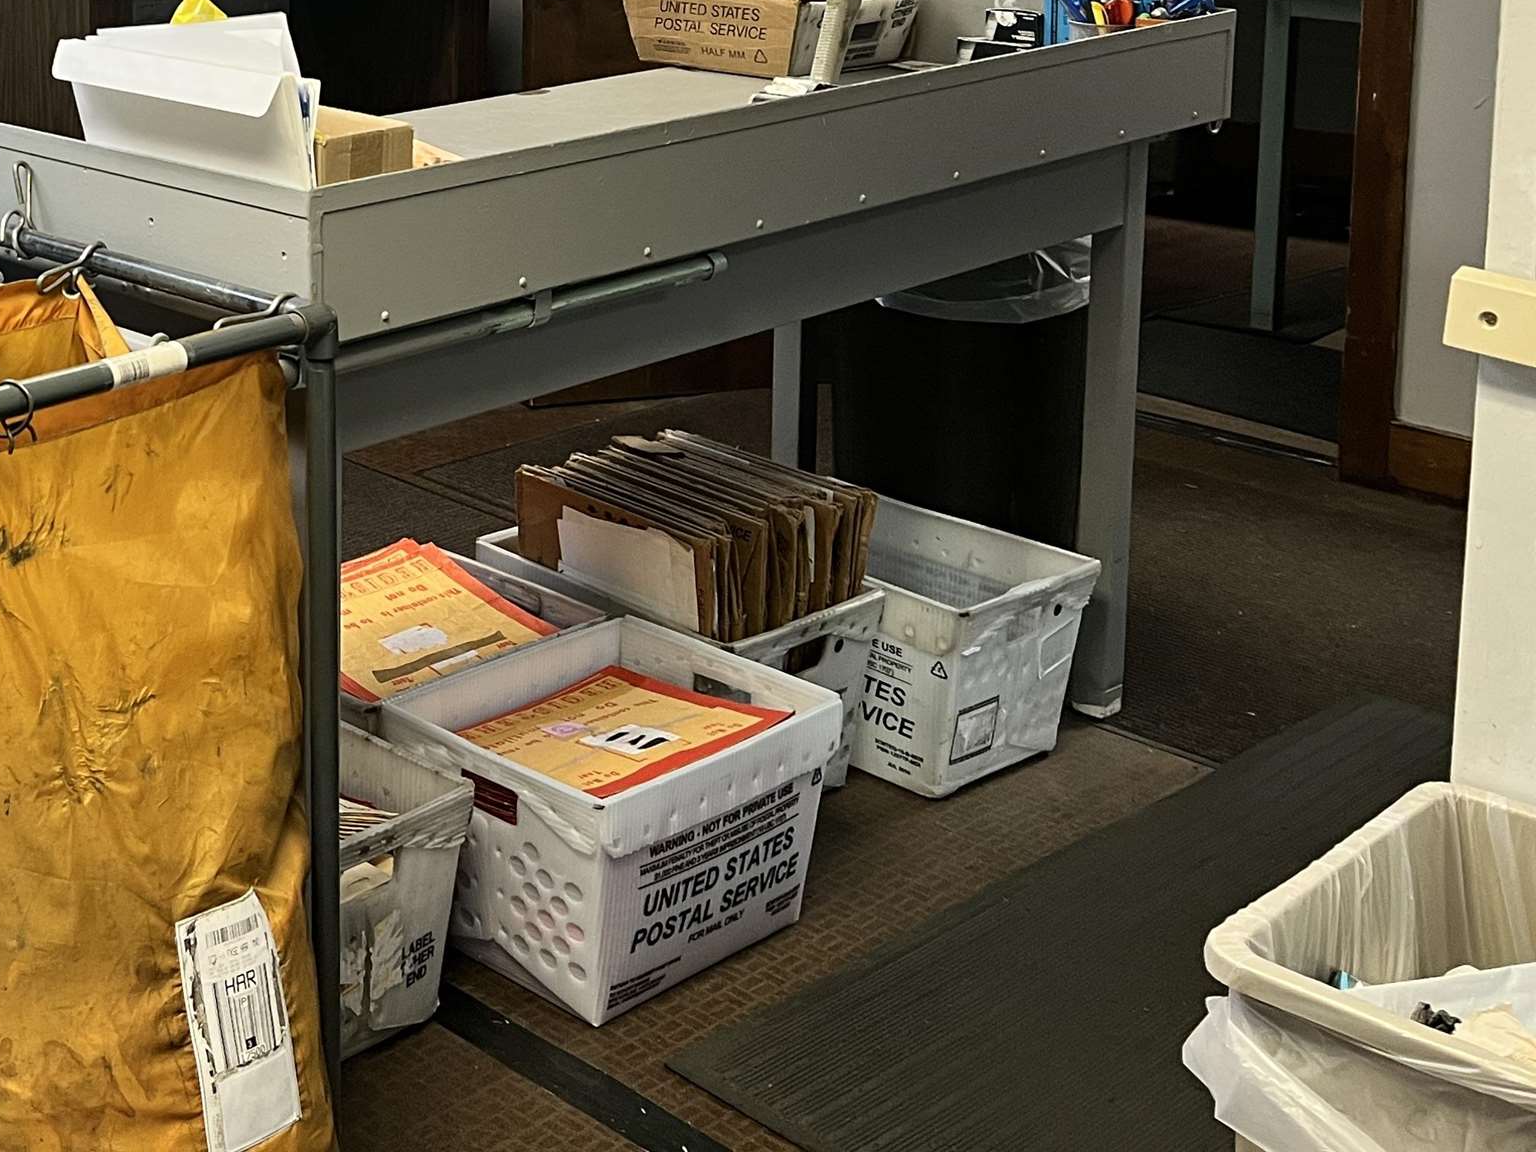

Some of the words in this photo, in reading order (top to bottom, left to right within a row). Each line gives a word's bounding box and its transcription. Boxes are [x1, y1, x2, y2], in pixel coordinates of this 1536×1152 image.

[659, 0, 707, 16] UNITED
[710, 4, 761, 21] STATES
[655, 17, 705, 34] POSTAL
[709, 22, 768, 40] SERVICE
[701, 47, 724, 57] HALF
[728, 50, 746, 59] MM
[872, 638, 881, 649] E
[881, 641, 903, 658] USE
[864, 674, 907, 707] TES
[860, 701, 916, 739] VICE
[649, 830, 695, 858] WARNING
[702, 818, 722, 837] NOT
[722, 810, 742, 828] FOR
[742, 794, 777, 817] PRIVATE
[777, 783, 794, 801] USE
[643, 866, 719, 917] UNITED
[724, 826, 795, 882] STATES
[630, 899, 714, 954] POSTAL
[720, 852, 799, 913] SERVICE
[687, 928, 705, 943] FOR
[706, 921, 723, 936] MAIL
[724, 909, 745, 927] ONLY
[402, 931, 436, 960] LABEL
[400, 945, 435, 977] OHER
[225, 969, 257, 995] HAR
[406, 965, 427, 988] END
